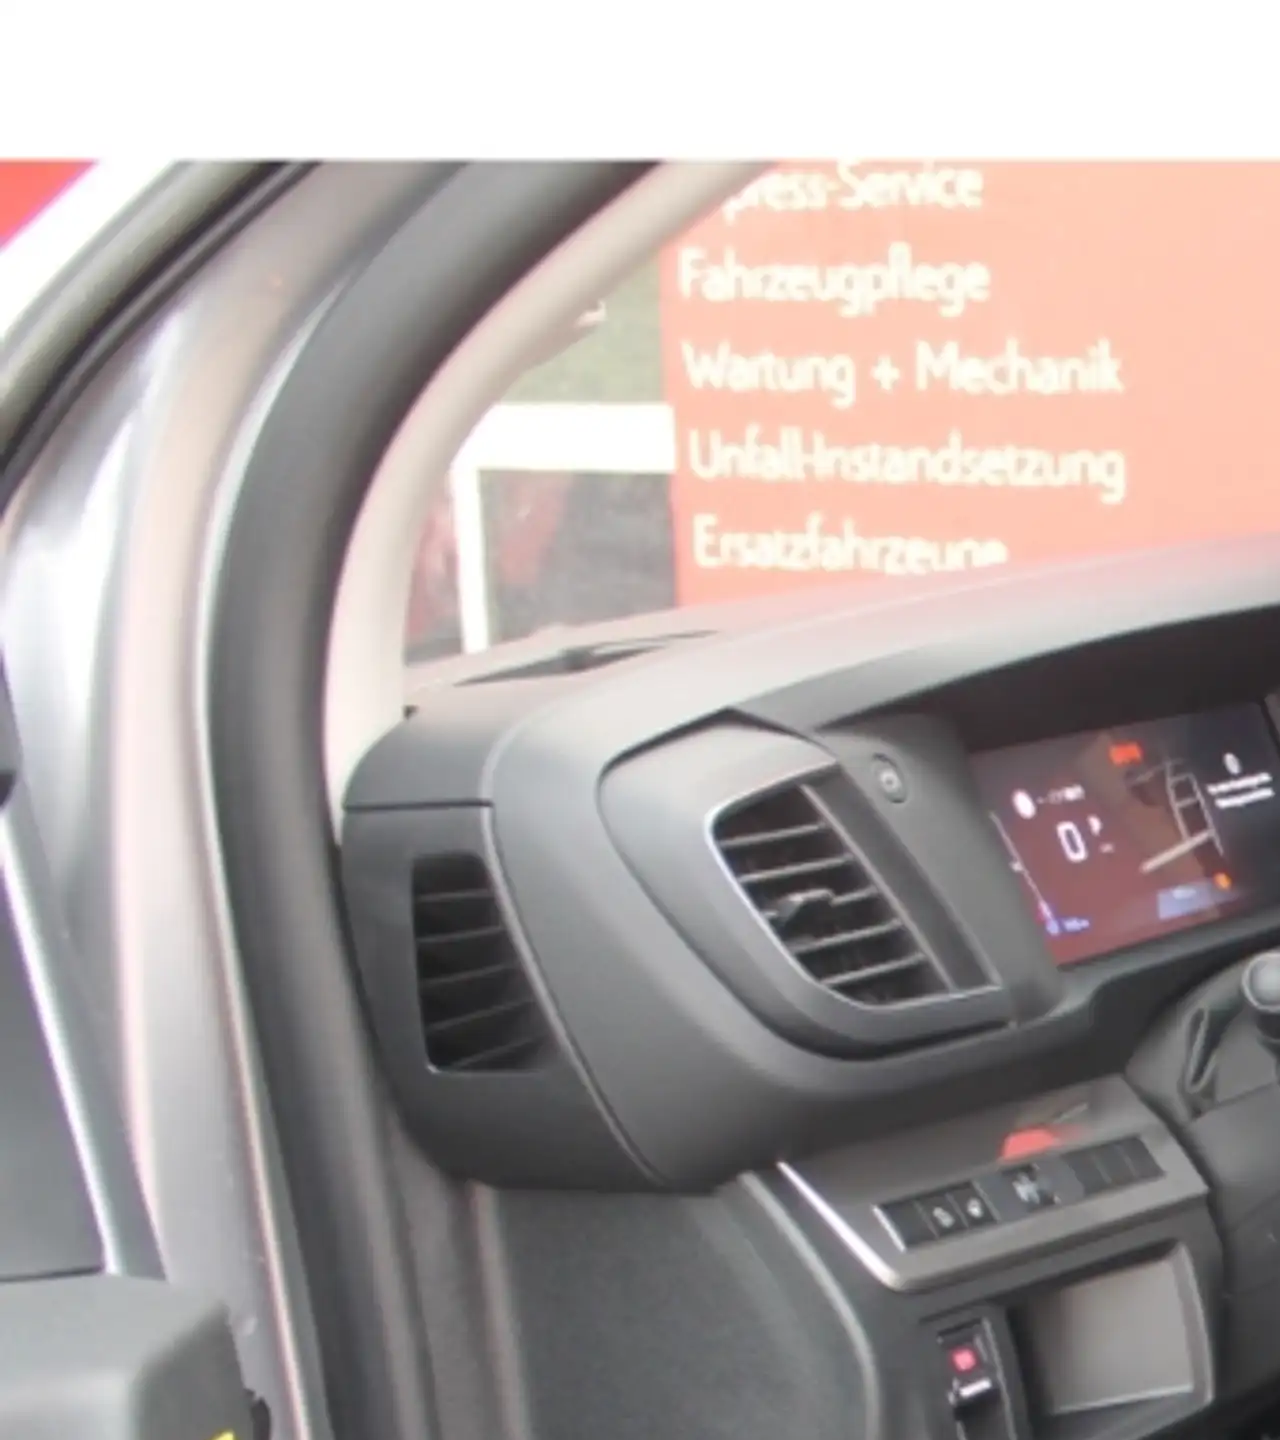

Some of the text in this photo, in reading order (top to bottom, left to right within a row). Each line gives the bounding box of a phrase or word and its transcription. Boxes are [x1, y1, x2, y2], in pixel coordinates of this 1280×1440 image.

[678, 241, 991, 317] Fahrzeugpflege
[681, 338, 1123, 409] Wartung + Mechanik
[688, 424, 1127, 505] Unfall-Instandsetzung
